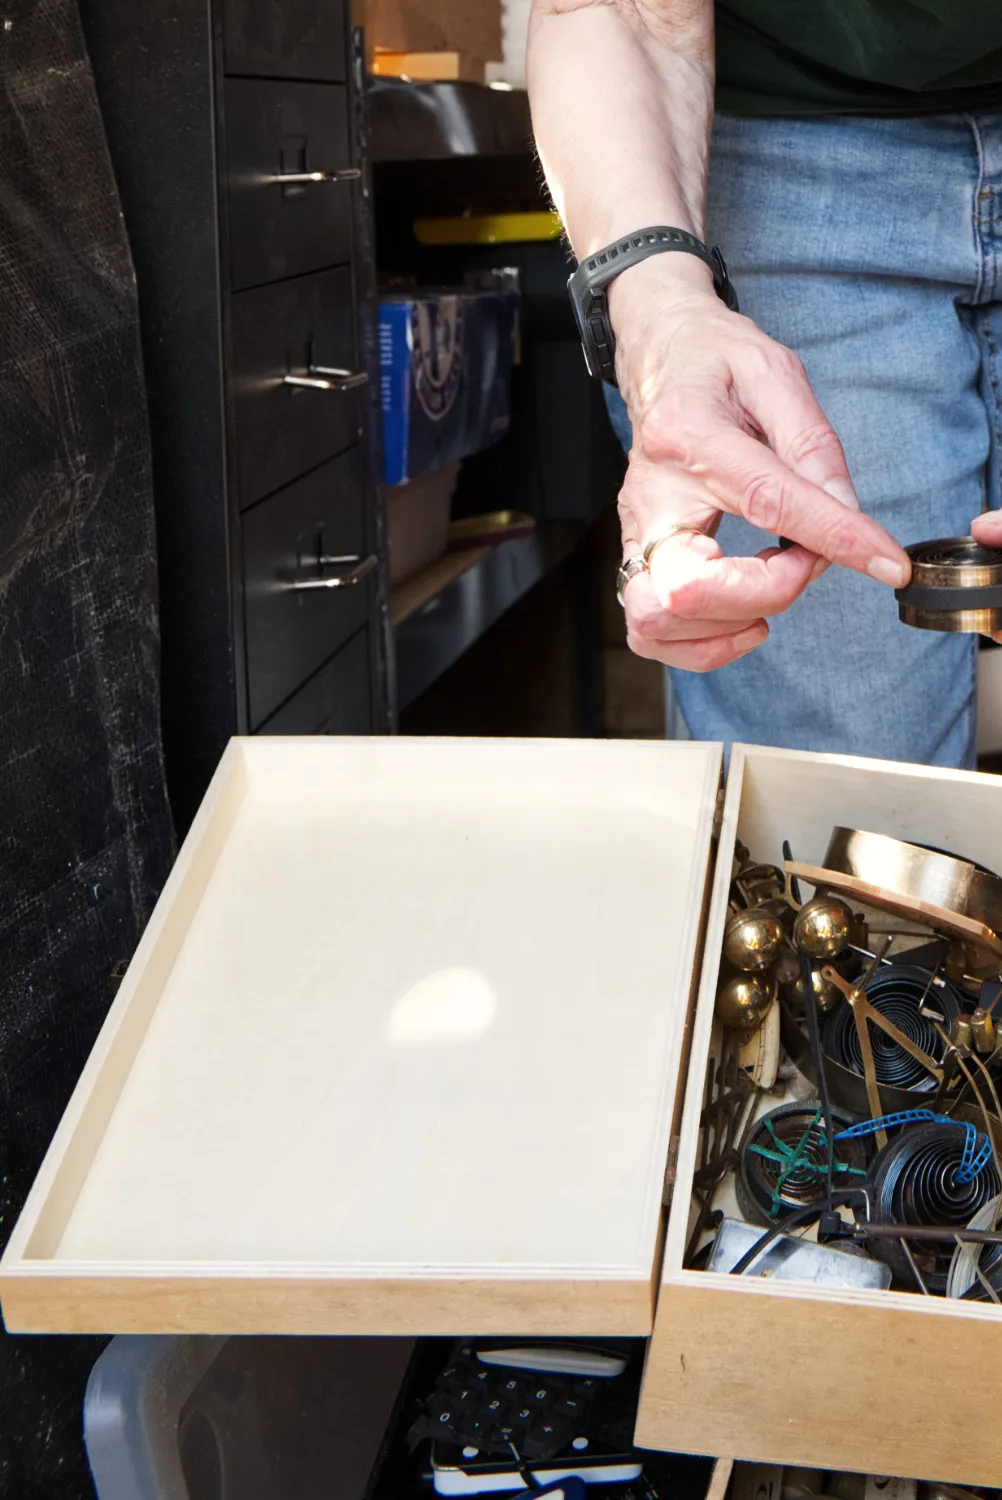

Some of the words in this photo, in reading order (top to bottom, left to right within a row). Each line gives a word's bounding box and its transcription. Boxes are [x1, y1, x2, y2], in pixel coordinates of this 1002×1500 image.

[536, 1390, 546, 1399] 6
[489, 1401, 499, 1410] 2
[520, 1409, 530, 1418] 3
